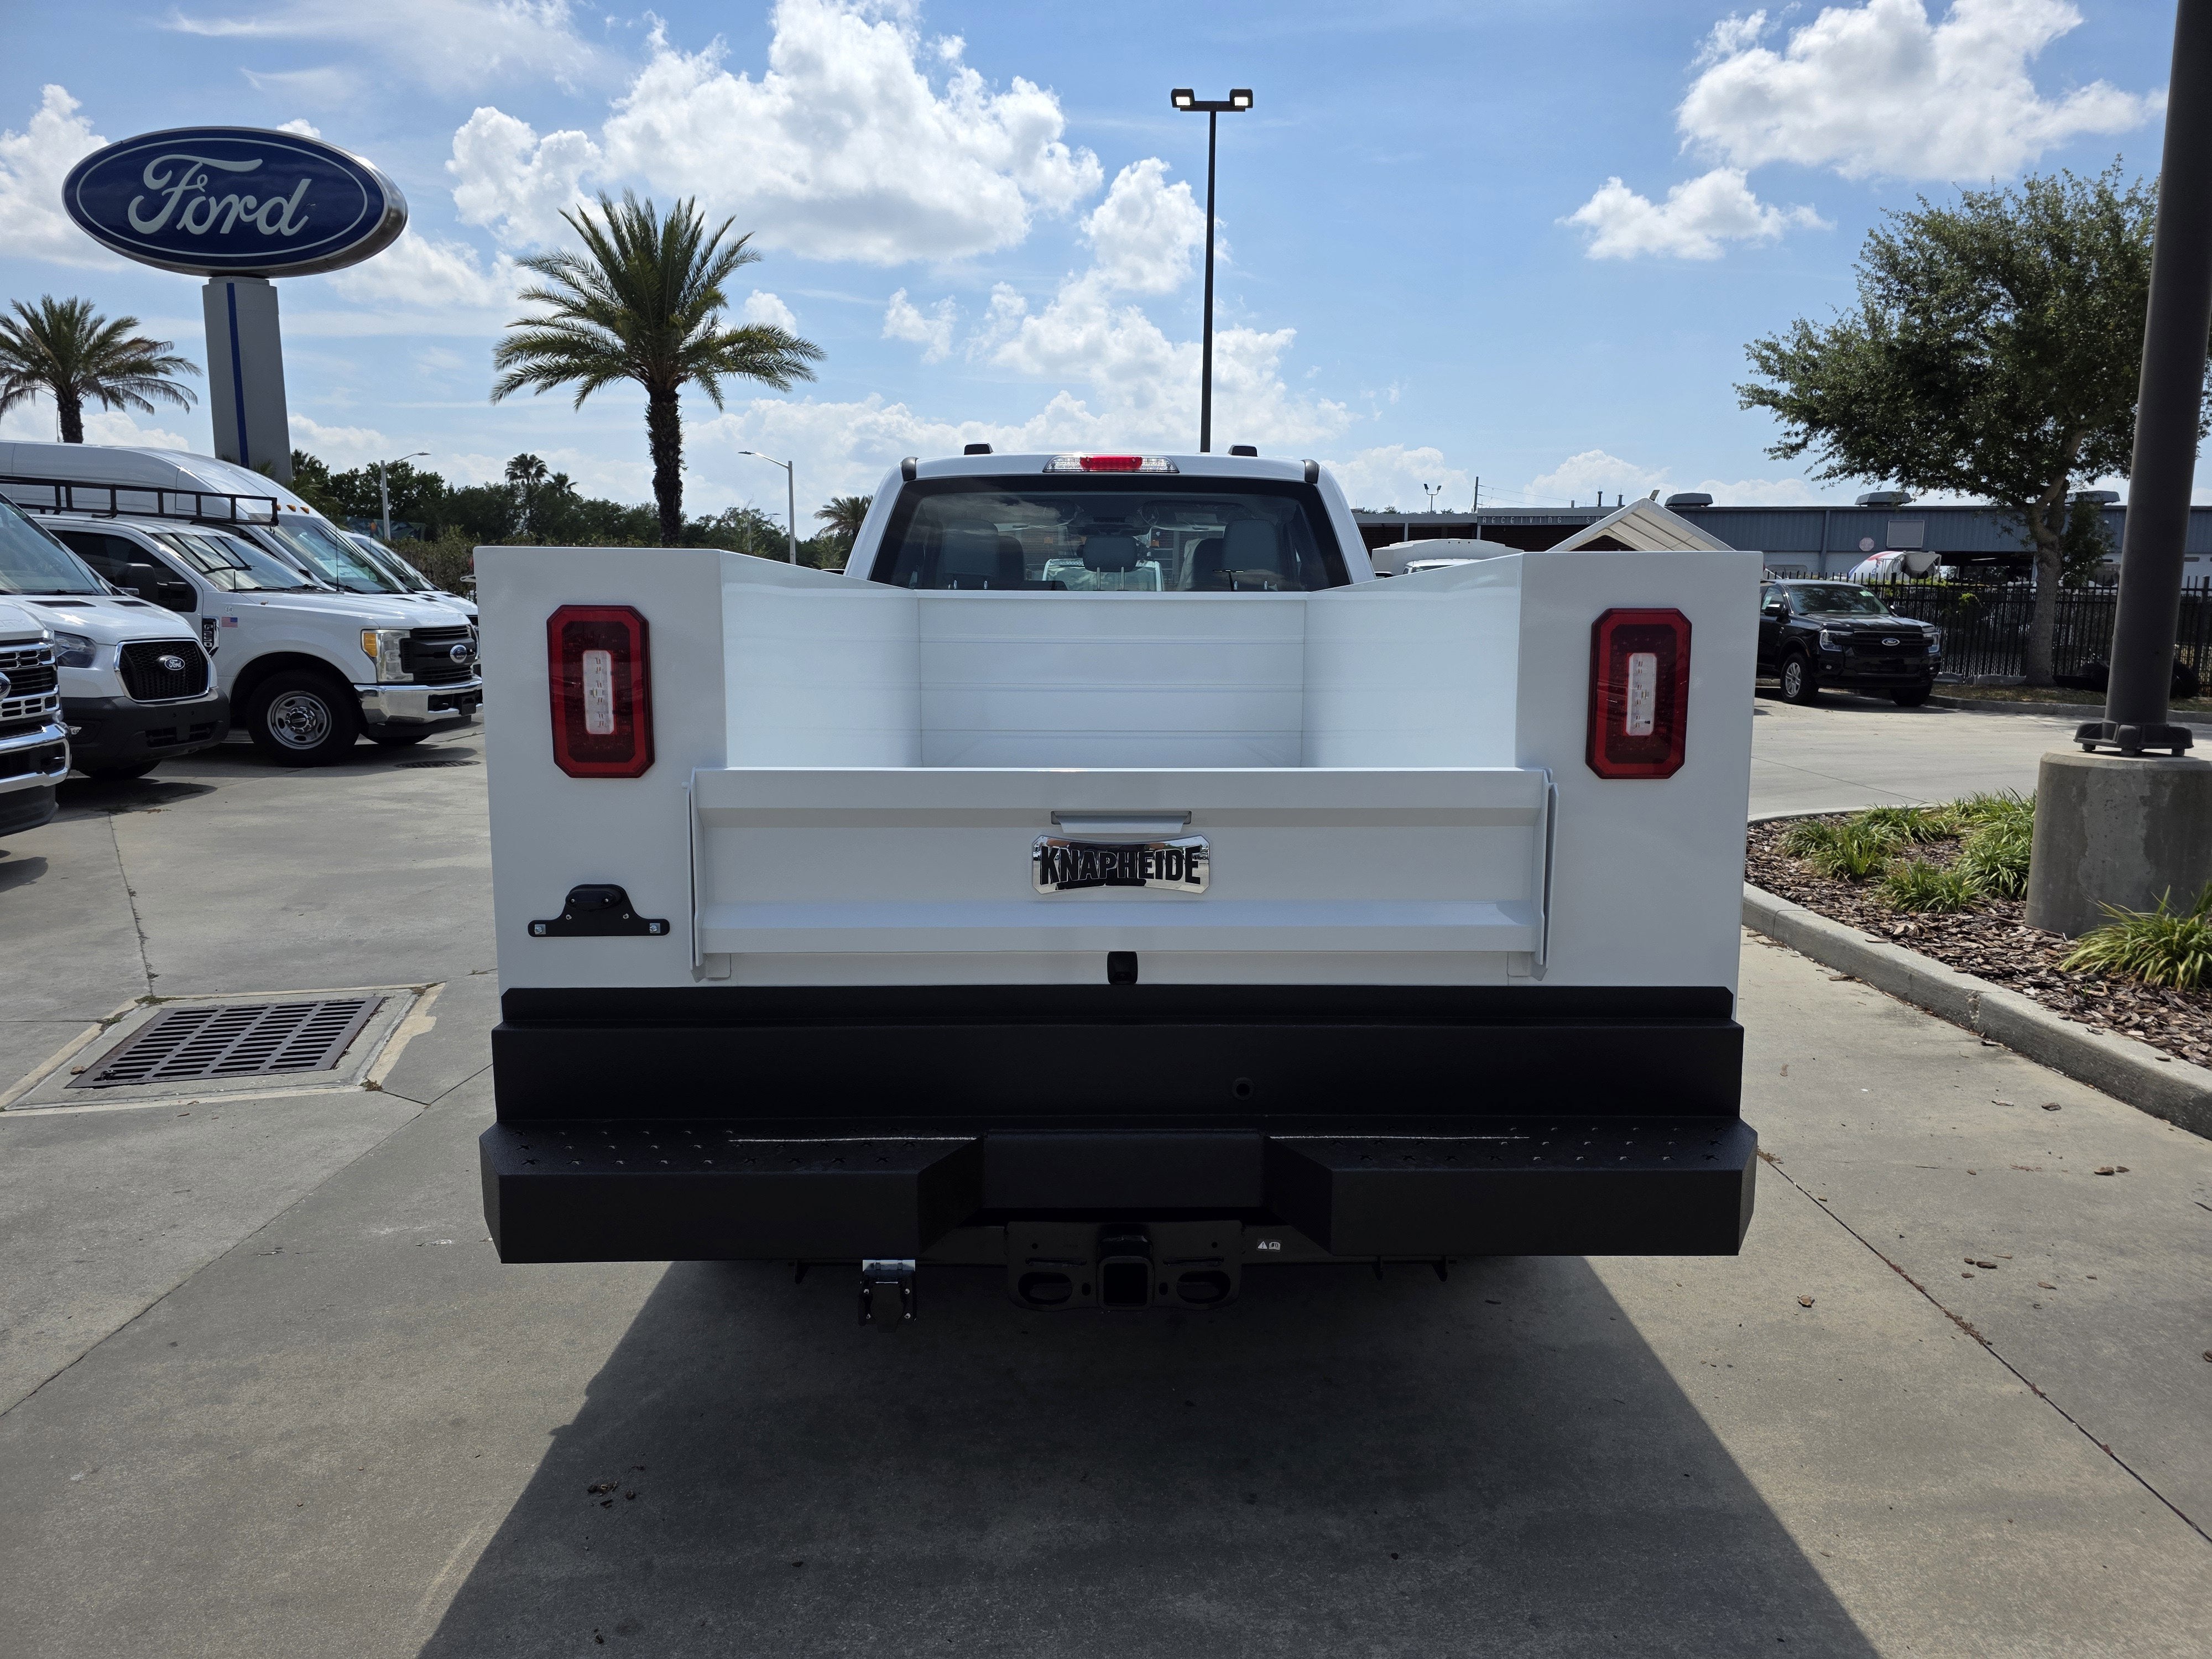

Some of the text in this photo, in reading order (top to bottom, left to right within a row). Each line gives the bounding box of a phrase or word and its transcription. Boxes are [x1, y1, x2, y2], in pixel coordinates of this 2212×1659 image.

[128, 154, 312, 236] Ford
[1482, 516, 1562, 524] RECEIVING
[169, 659, 182, 668] Ford
[1040, 845, 1201, 885] KNAPHEIDE
